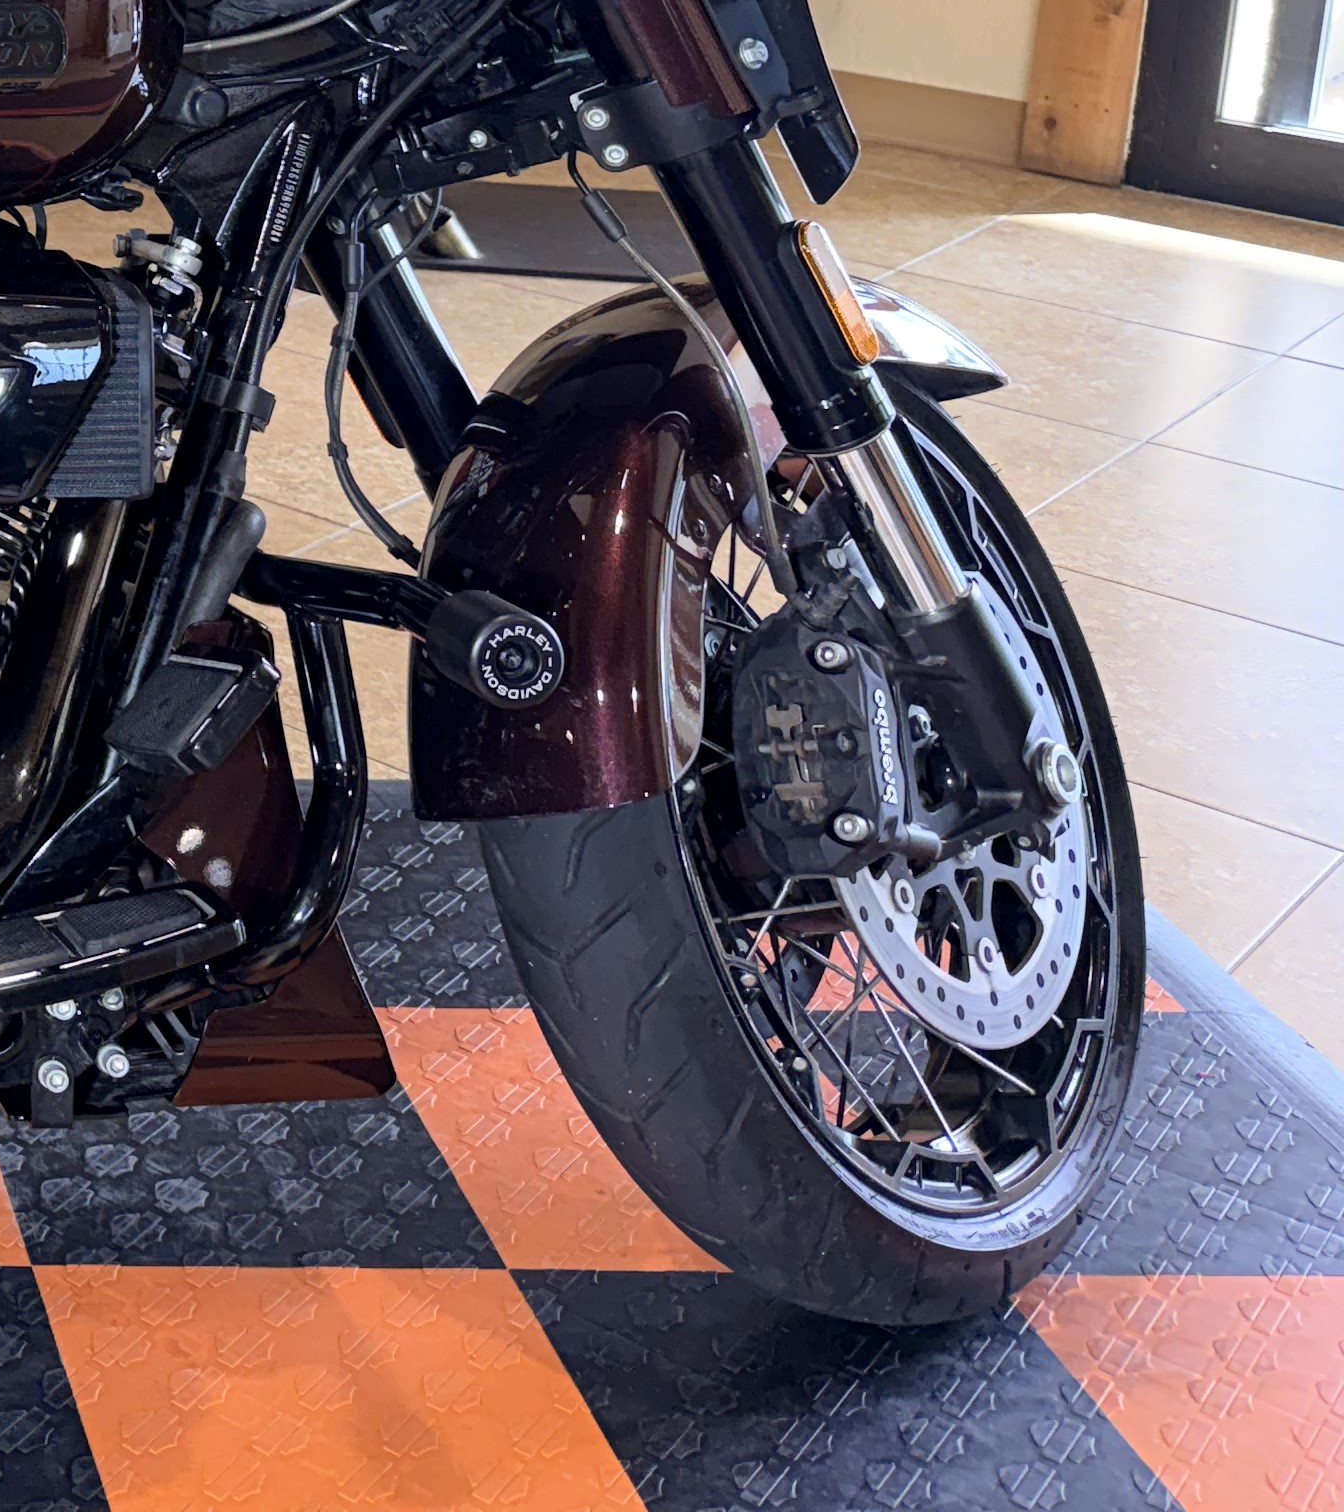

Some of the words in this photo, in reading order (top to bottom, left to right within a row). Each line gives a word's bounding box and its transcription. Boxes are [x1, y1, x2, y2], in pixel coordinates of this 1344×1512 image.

[488, 625, 554, 649] HARLEY
[481, 663, 553, 700] DAVIDSON
[874, 688, 898, 805] brembo
